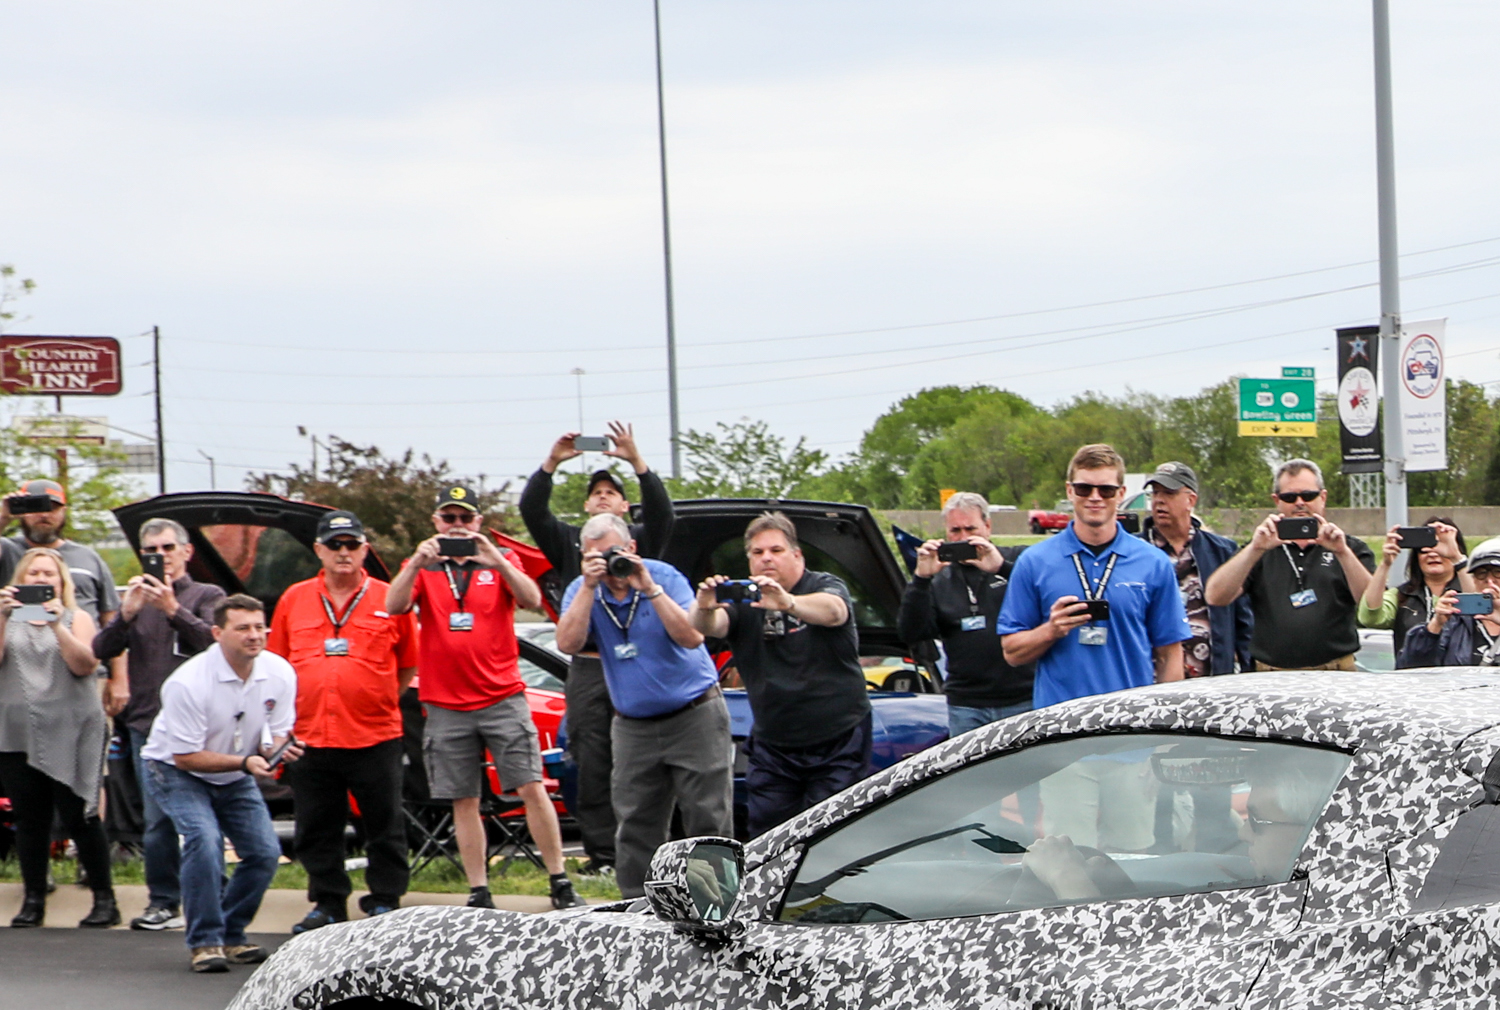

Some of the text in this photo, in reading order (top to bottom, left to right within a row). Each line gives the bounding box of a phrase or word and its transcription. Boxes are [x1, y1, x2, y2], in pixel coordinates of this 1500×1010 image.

[13, 349, 98, 360] COUNTRY
[20, 360, 97, 372] HEARTH
[1301, 369, 1313, 377] 28
[31, 373, 88, 388] INN
[1242, 410, 1313, 422] Bowling Green
